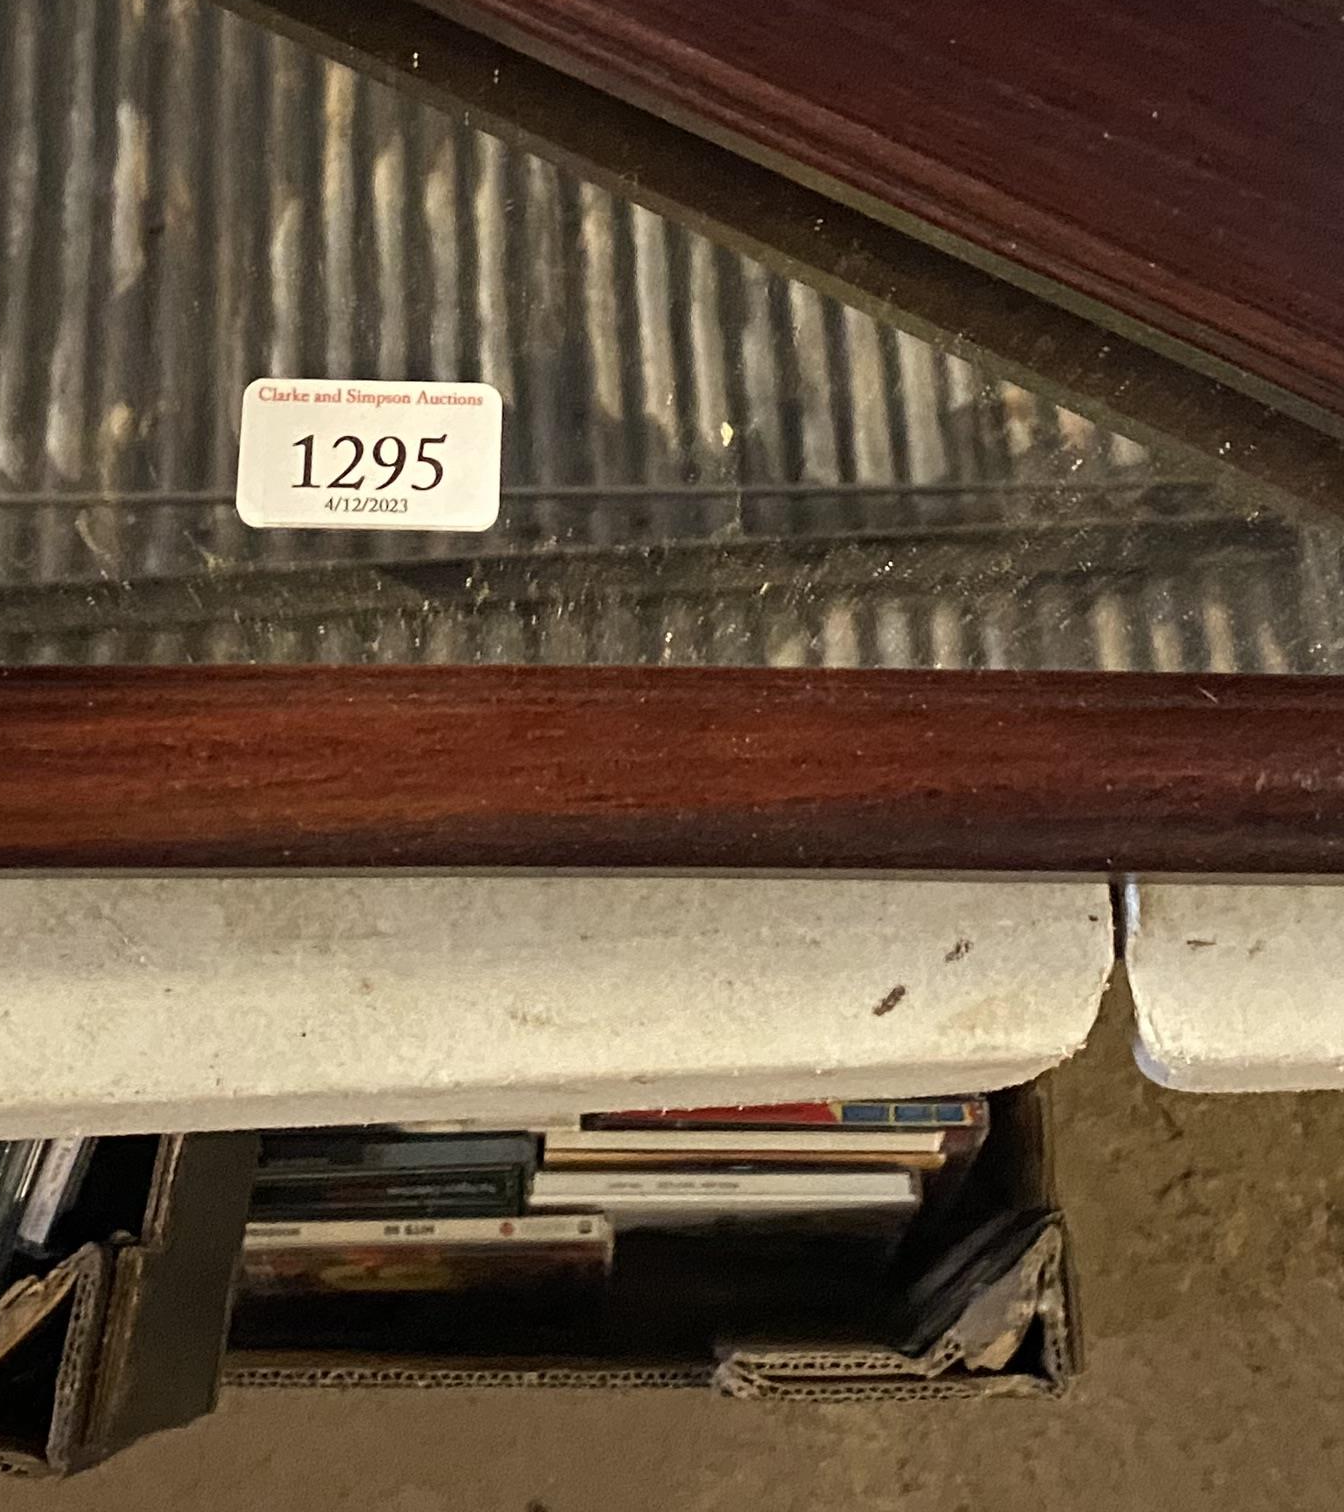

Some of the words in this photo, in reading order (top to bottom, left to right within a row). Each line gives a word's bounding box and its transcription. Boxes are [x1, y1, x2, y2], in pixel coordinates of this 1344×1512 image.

[258, 387, 310, 403] Clarke
[314, 389, 342, 405] and
[346, 390, 411, 408] Simpson
[416, 390, 484, 406] Auctions
[291, 434, 448, 491] 1295
[324, 497, 408, 514] 4/12/2023
